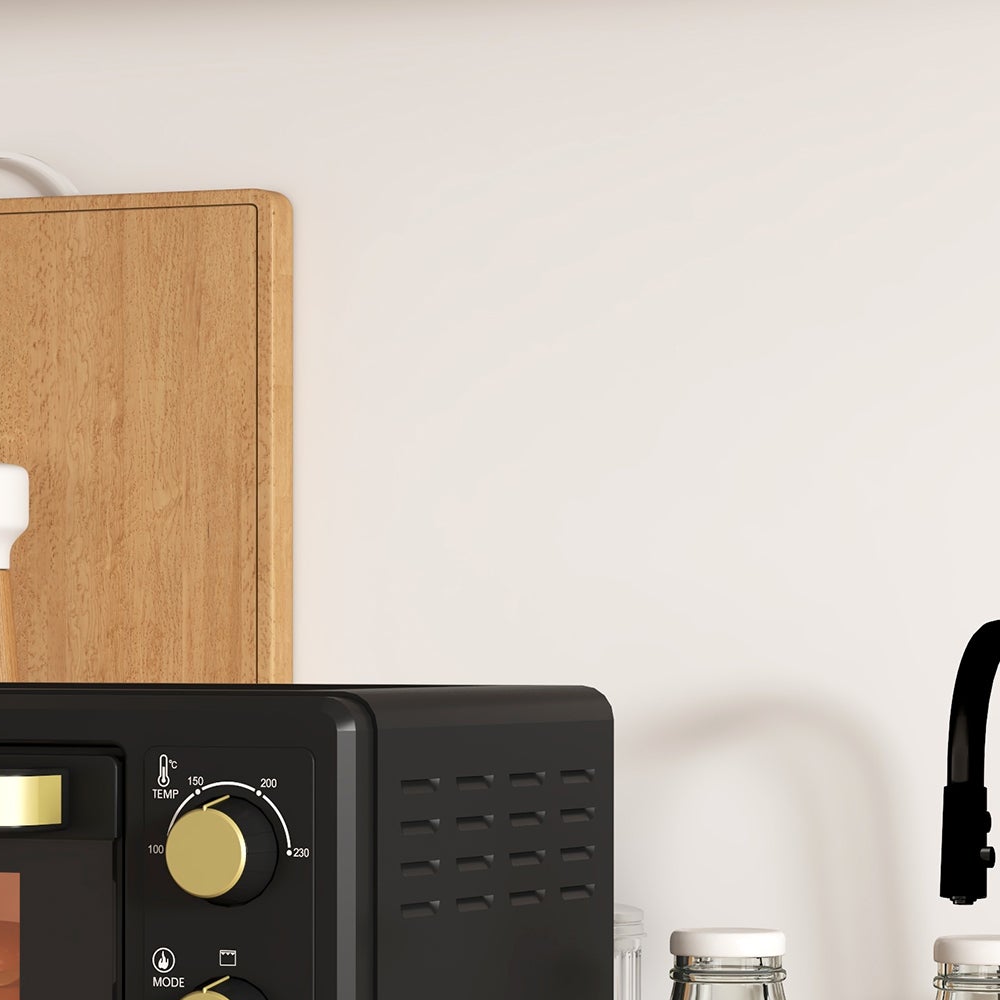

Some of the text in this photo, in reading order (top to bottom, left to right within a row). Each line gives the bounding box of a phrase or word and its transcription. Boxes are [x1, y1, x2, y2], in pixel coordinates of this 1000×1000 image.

[188, 776, 204, 786] 150
[260, 778, 277, 788] 200
[152, 789, 179, 799] TEMP
[148, 845, 164, 854] 100
[293, 848, 309, 857] 230
[153, 977, 184, 987] MODE
